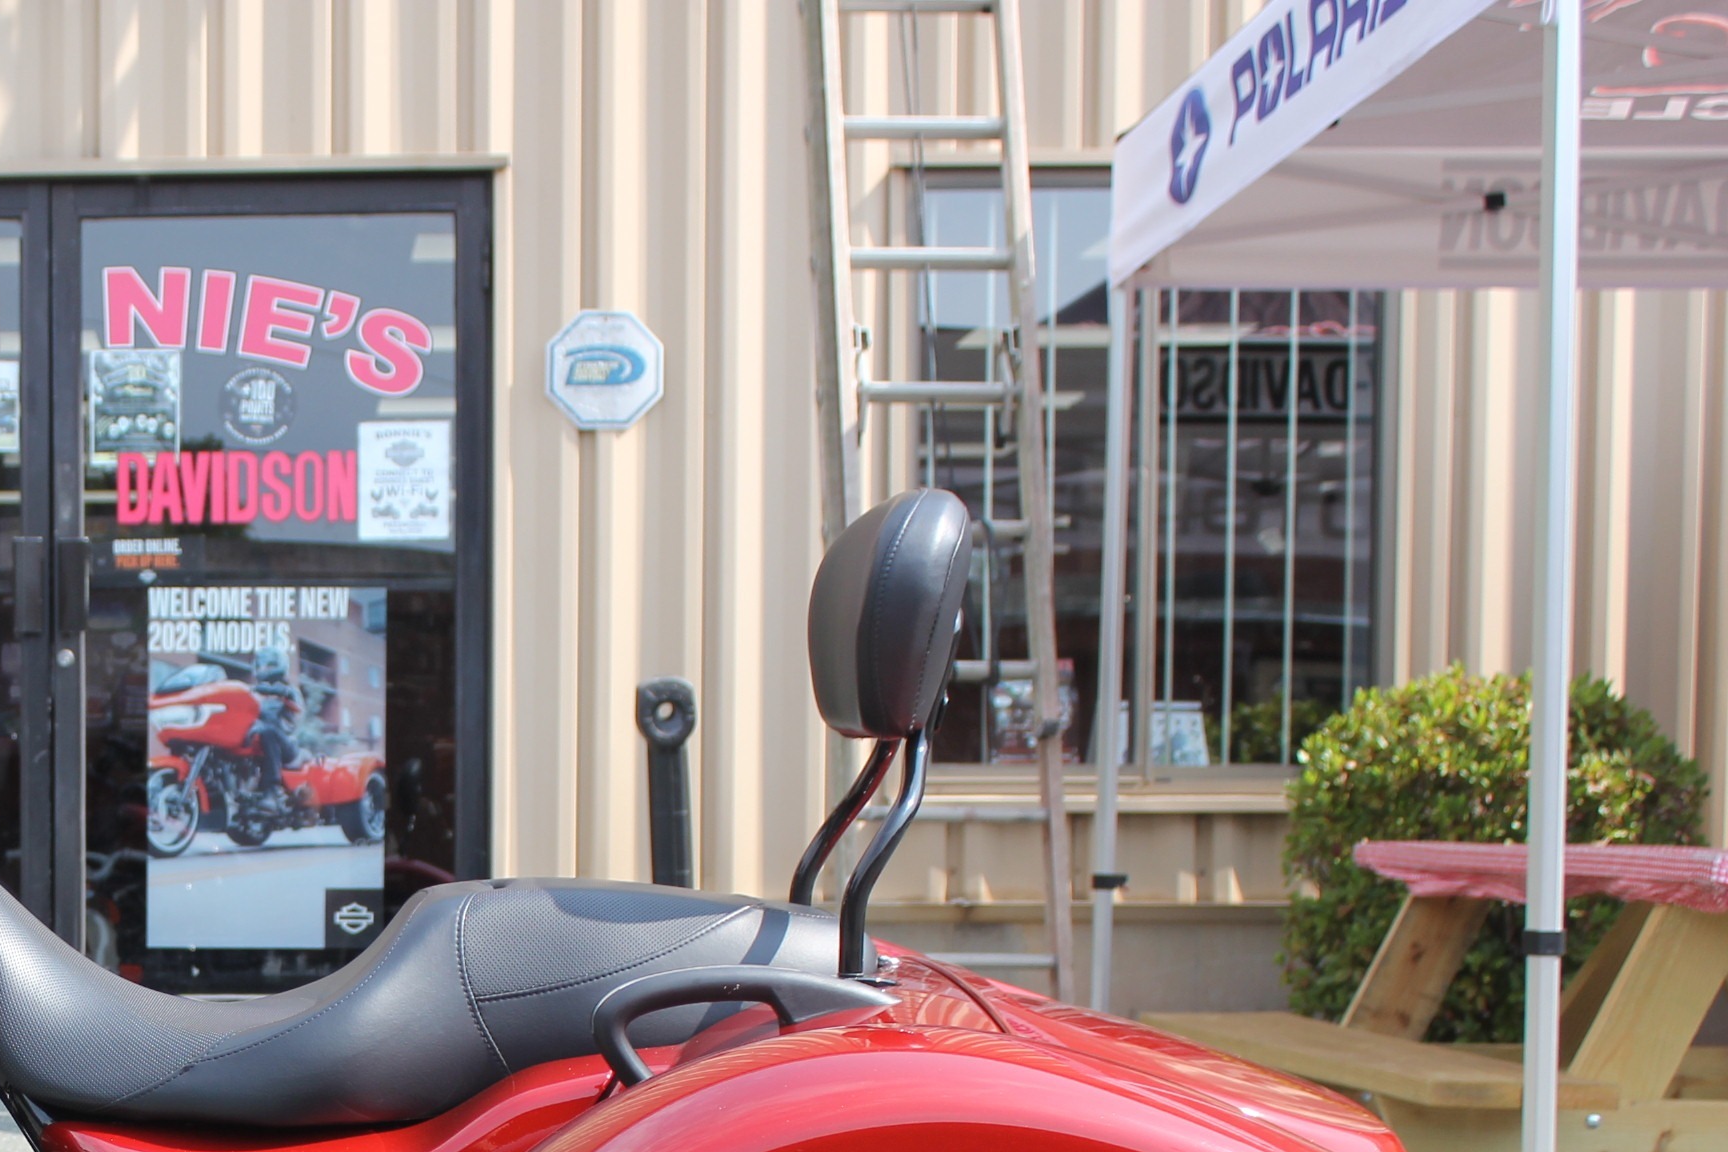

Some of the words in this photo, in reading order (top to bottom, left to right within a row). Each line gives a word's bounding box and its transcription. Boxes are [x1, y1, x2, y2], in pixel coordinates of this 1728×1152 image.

[103, 266, 433, 397] NIE'S
[116, 450, 357, 525] DAVIDSON
[147, 587, 252, 620] WELCOME
[256, 587, 296, 620] THE
[300, 587, 350, 620] NEW
[147, 621, 202, 653] 2026
[206, 621, 296, 654] MODELS.
